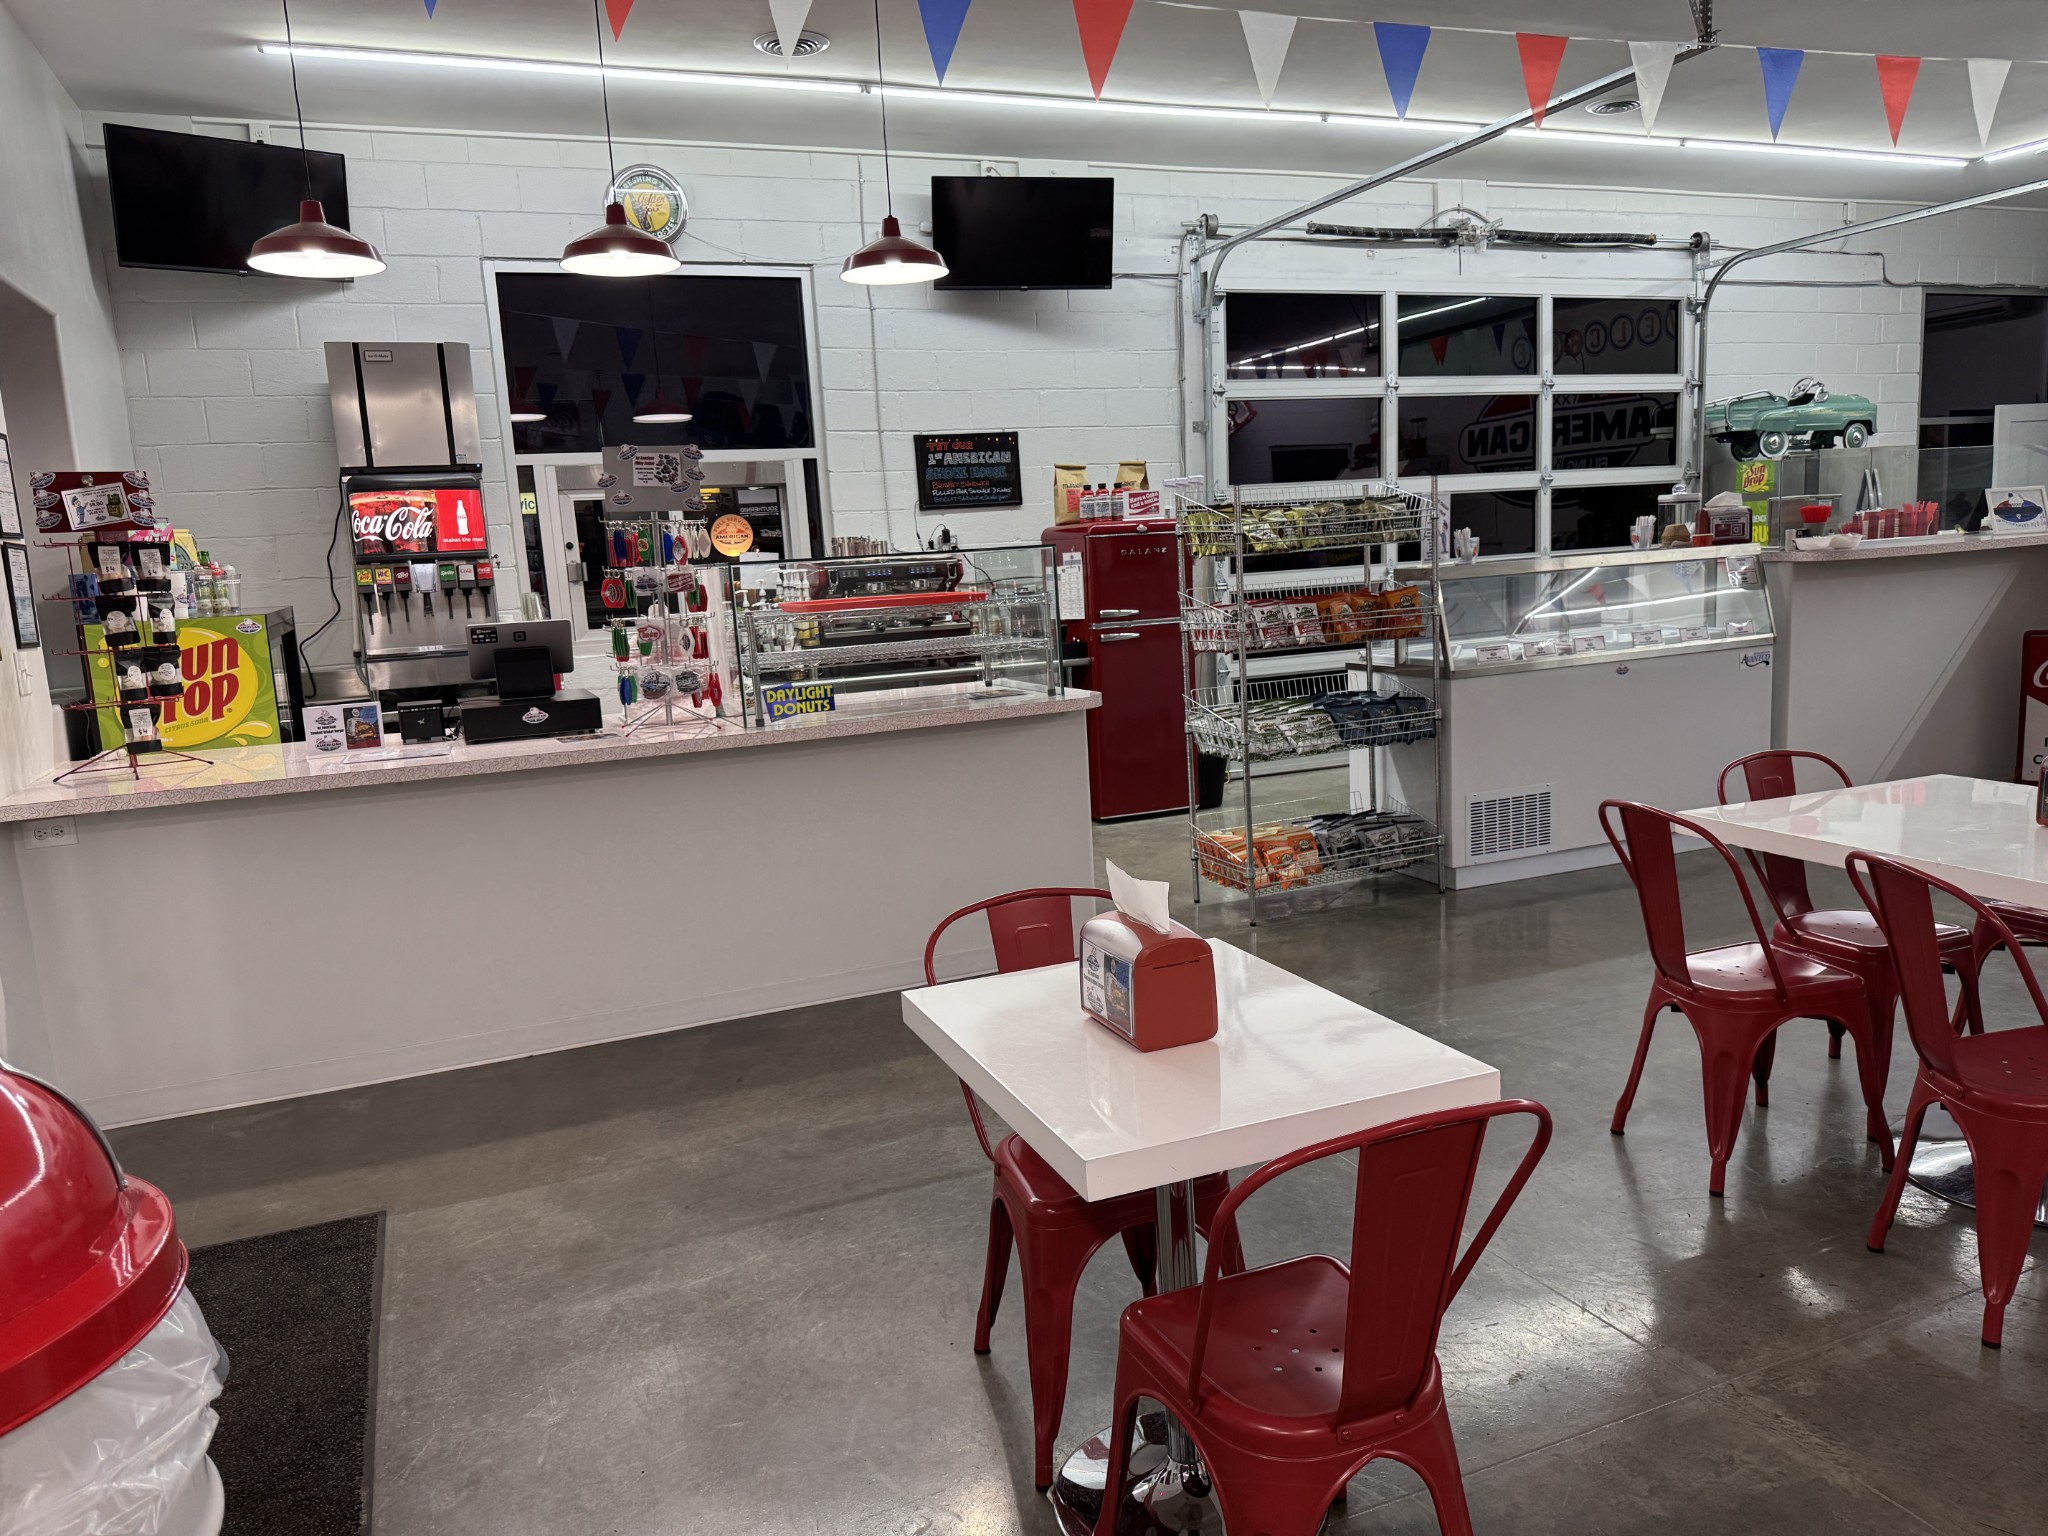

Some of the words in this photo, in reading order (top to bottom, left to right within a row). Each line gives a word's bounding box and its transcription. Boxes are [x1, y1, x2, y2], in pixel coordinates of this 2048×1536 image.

[943, 451, 1012, 465] AMERICAN
[925, 467, 968, 480] SMOKE
[970, 466, 1007, 478] HOUSE
[1746, 464, 1766, 477] Sun
[1743, 475, 1764, 488] Drop
[352, 507, 434, 542] Coca-Cola
[713, 519, 726, 533] FULL
[726, 516, 749, 531] SERVICE
[1121, 547, 1167, 556] GALANZ
[181, 637, 240, 681] un
[163, 673, 240, 725] rop
[767, 685, 833, 703] DAYLIGHT
[774, 700, 831, 717] DONUTS
[138, 727, 148, 735] $4
[164, 721, 190, 734] CITRUS
